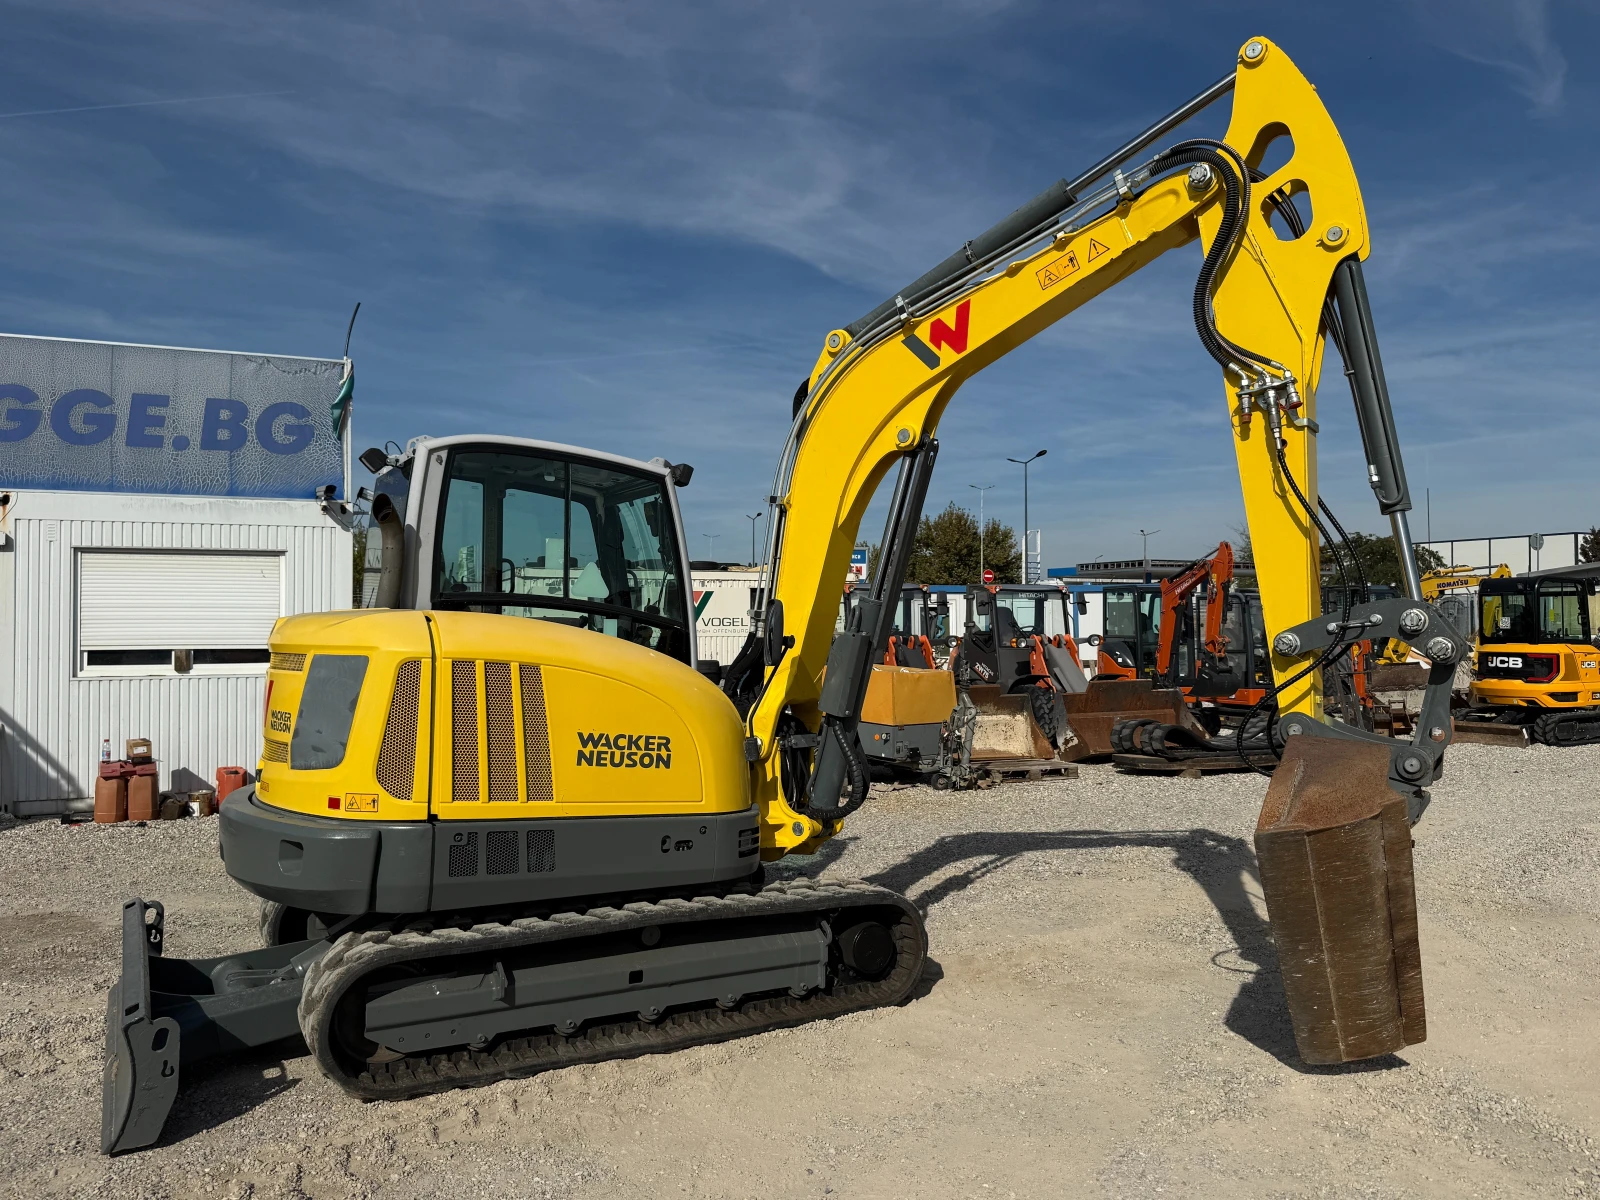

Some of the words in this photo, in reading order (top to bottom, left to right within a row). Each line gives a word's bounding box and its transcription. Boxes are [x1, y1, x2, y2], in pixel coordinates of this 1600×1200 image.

[1436, 579, 1469, 589] KOMATSU
[701, 617, 749, 627] VOGEL
[1488, 656, 1523, 669] JCB
[1581, 661, 1596, 669] JCB
[271, 709, 292, 723] WACKER
[270, 719, 291, 734] NEUSON
[577, 731, 672, 752] WACKER
[576, 749, 672, 769] NEUSON
